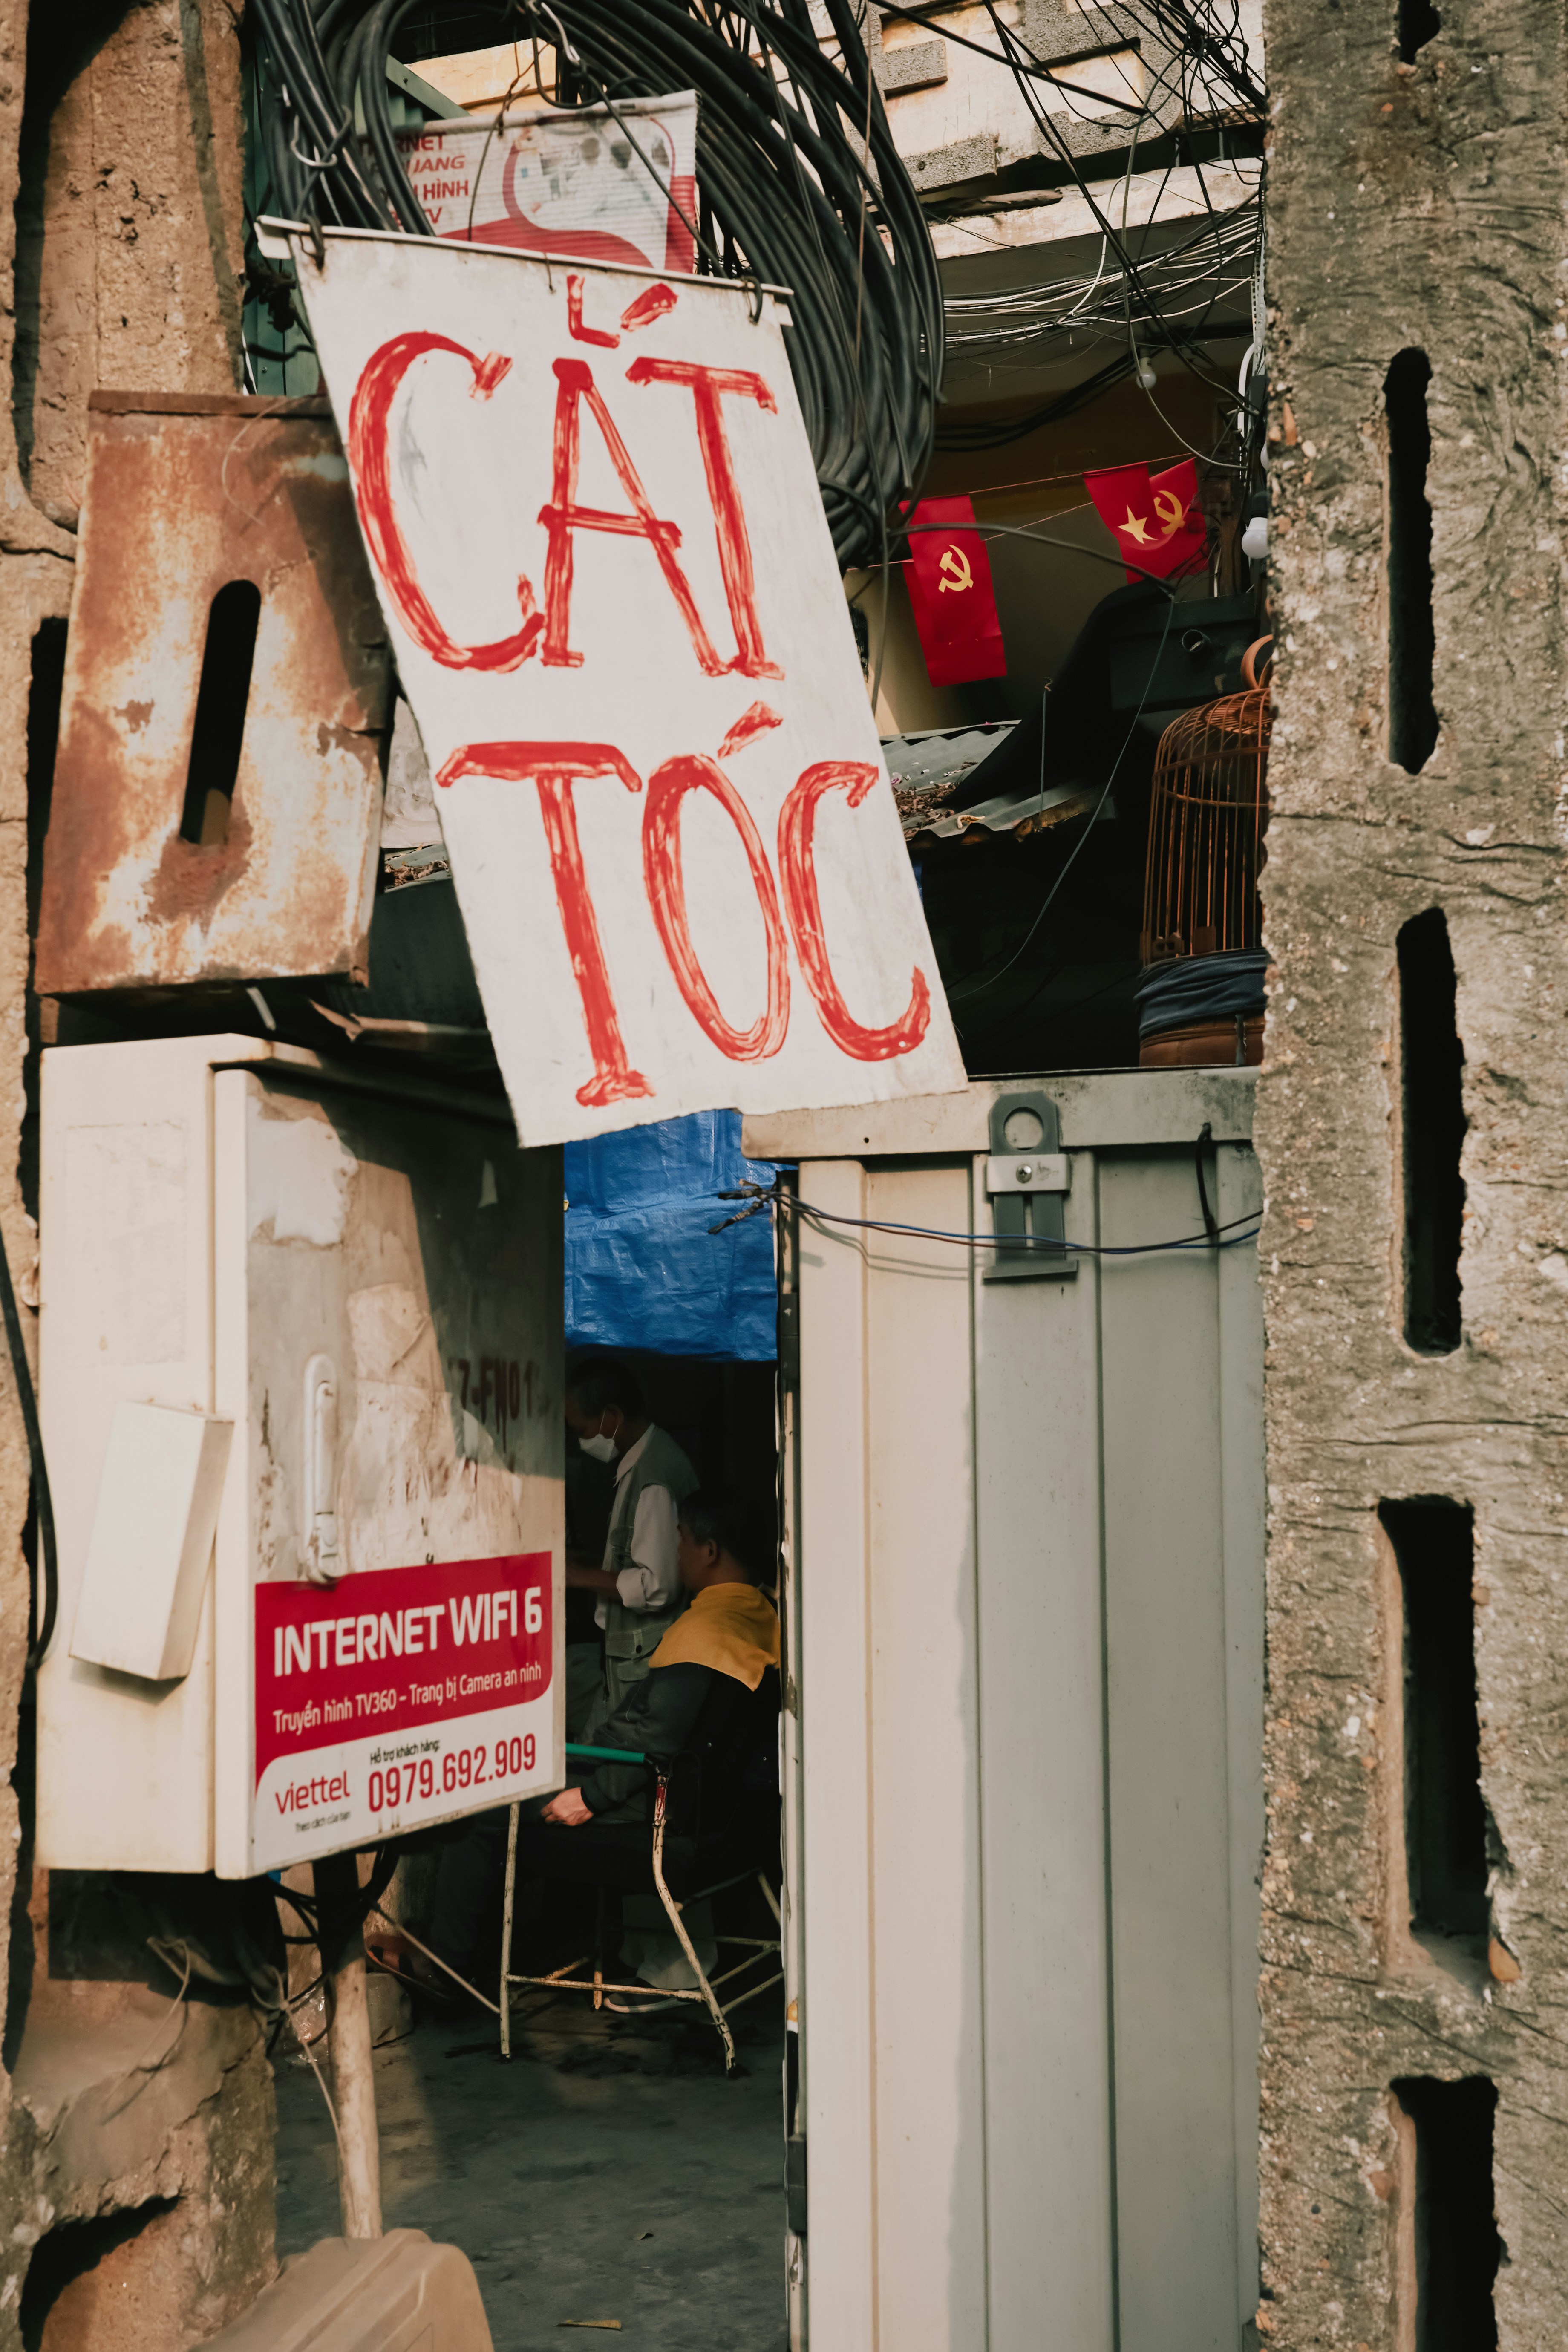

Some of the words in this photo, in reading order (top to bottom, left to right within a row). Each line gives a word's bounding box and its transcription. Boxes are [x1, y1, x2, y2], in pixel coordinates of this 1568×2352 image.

[423, 177, 469, 200] HÌNH
[348, 274, 785, 680] CẮT
[435, 700, 930, 1109] TÓC
[274, 1605, 445, 1677] INTERNET
[449, 1589, 517, 1647] WIFI
[525, 1586, 542, 1634] 6
[355, 1688, 397, 1717] TV360
[409, 1683, 444, 1706] Trang
[446, 1675, 457, 1702] bị
[459, 1674, 502, 1696] Camera
[504, 1669, 517, 1687] an
[520, 1660, 542, 1683] ninh
[368, 1733, 536, 1813] 0979.692.909
[396, 1743, 419, 1758] khách
[275, 1770, 351, 1815] viettel
